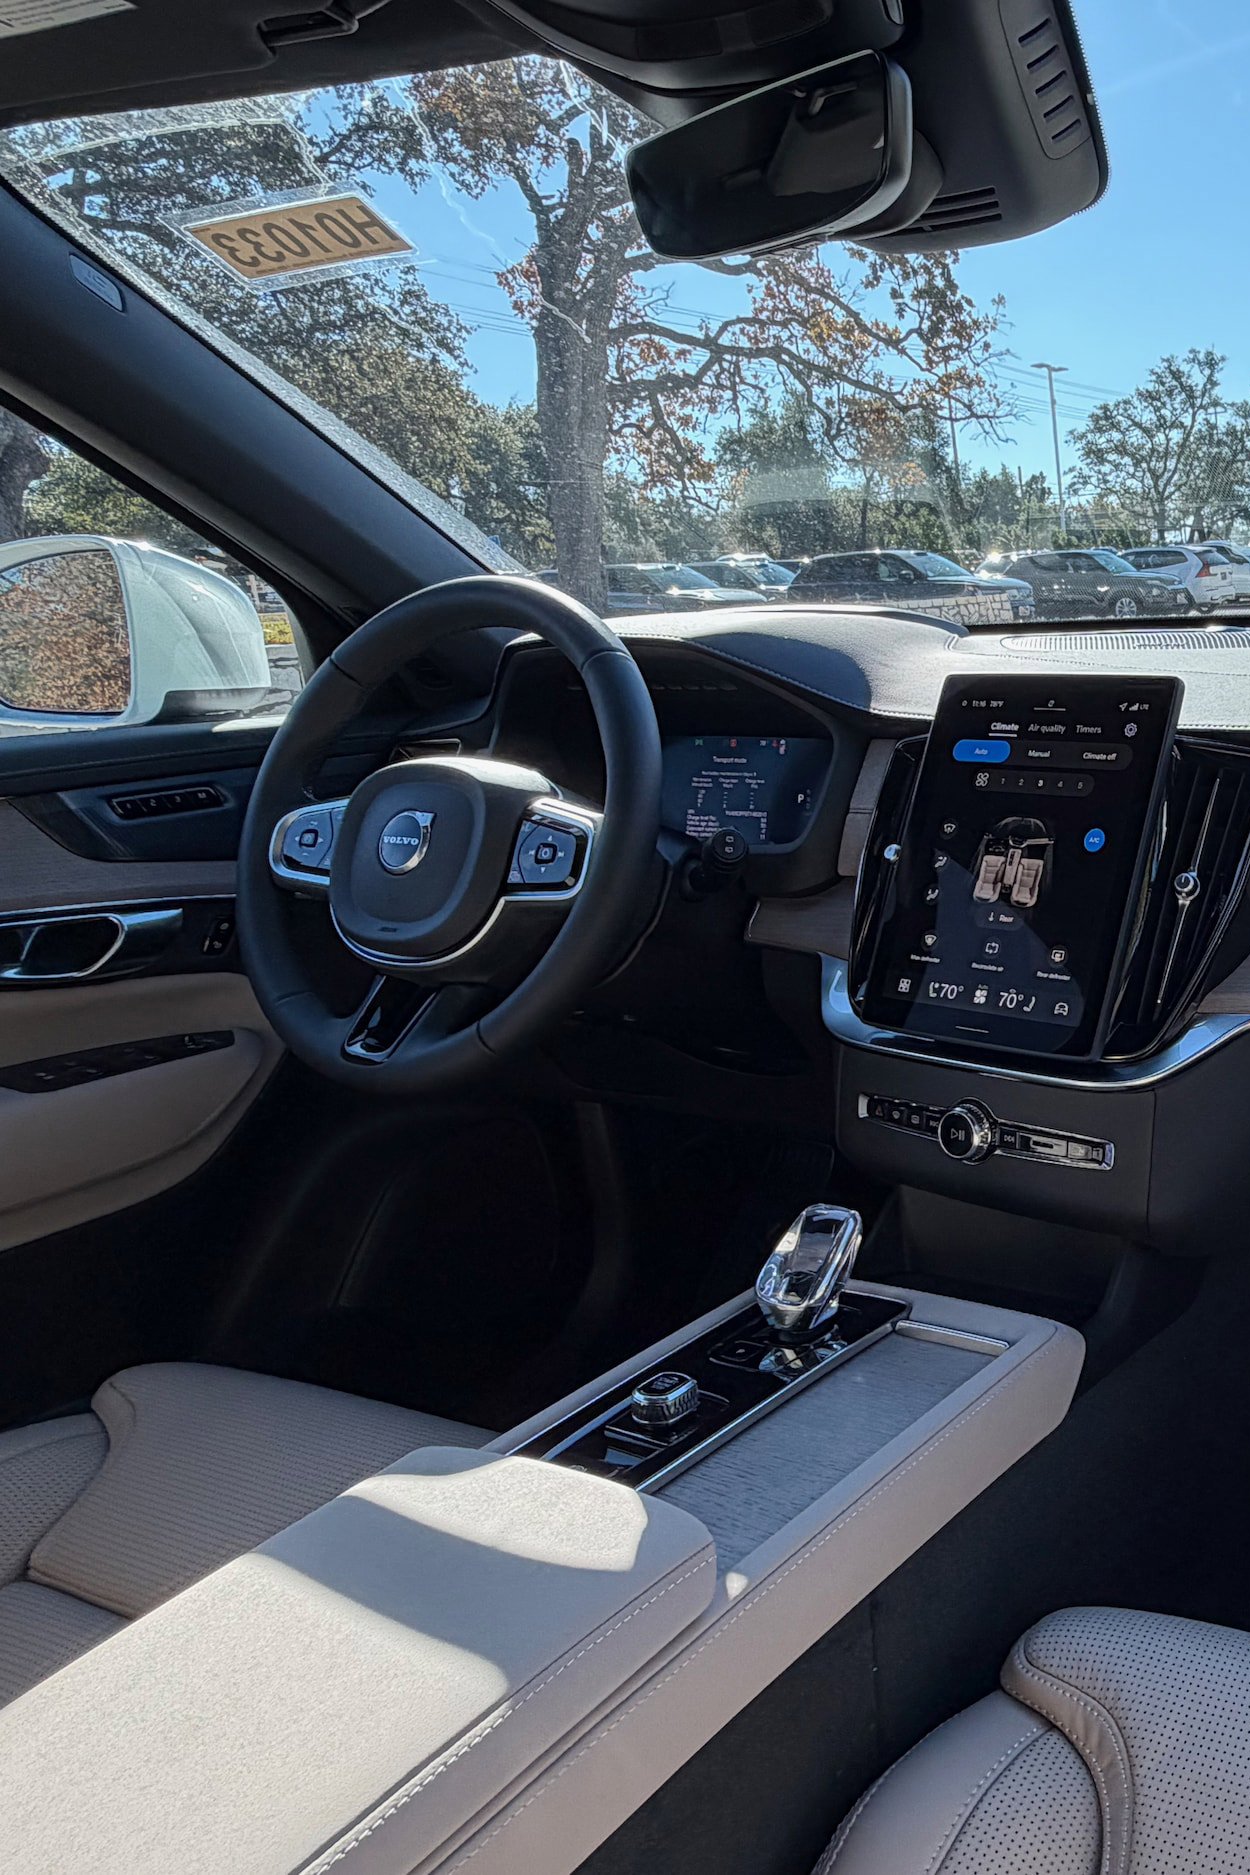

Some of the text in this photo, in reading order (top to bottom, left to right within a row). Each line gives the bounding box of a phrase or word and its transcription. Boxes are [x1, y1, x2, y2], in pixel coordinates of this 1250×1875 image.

[990, 722, 1019, 732] Climate
[1028, 723, 1066, 735] Air quality
[1075, 725, 1102, 734] Timers
[1028, 750, 1051, 758] Manual
[1082, 752, 1118, 761] Climate off
[798, 793, 805, 804] P
[383, 835, 420, 846] VOLVO
